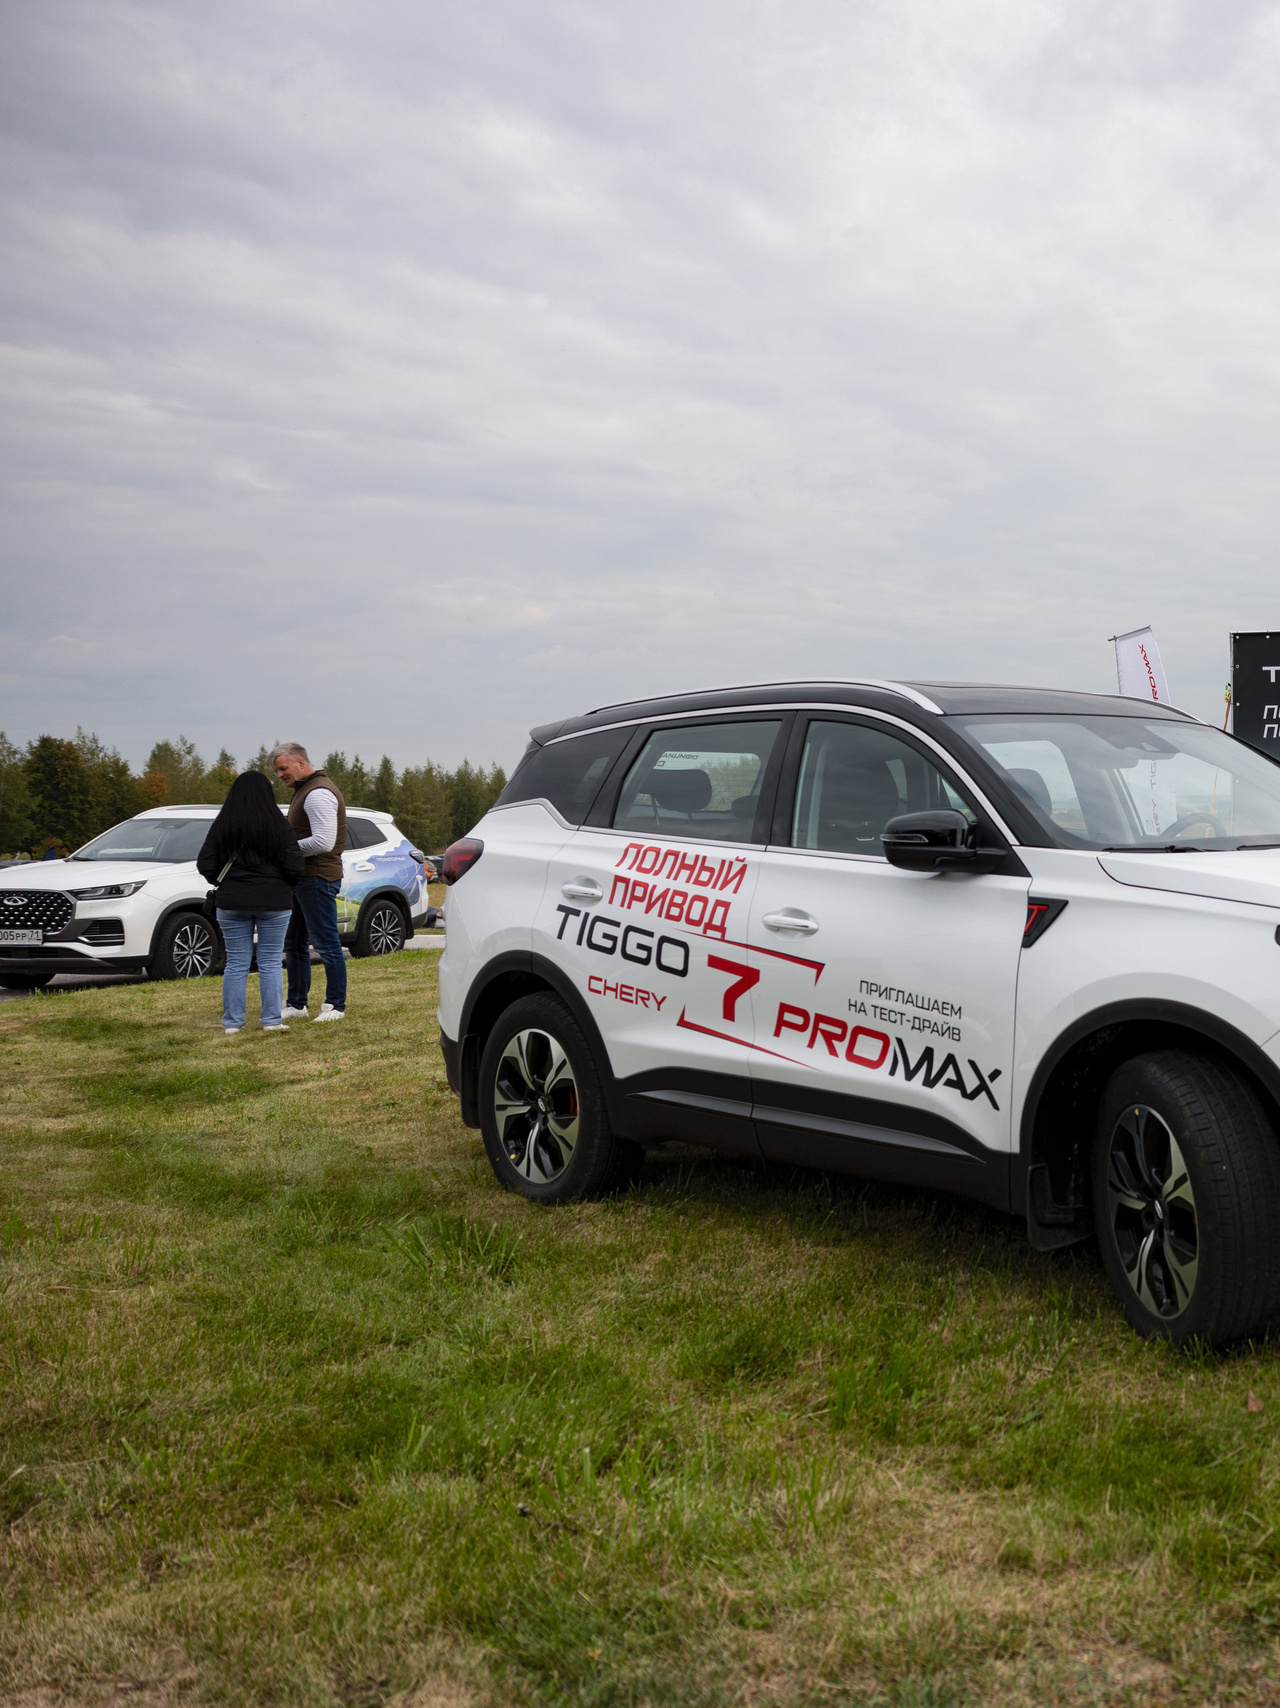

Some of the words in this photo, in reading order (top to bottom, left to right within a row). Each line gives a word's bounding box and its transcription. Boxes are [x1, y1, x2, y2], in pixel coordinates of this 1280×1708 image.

[615, 842, 748, 894] ПОЛНЫЙ
[608, 874, 732, 940] ПРИВОД
[556, 904, 690, 978] TIGGO
[707, 953, 761, 1023] 7
[588, 975, 667, 1012] CHERY
[859, 980, 962, 1020] ПРИГЛАШАЕМ
[848, 998, 867, 1016] НА
[871, 1004, 962, 1042] ТЕСТ-ДРАЙВ
